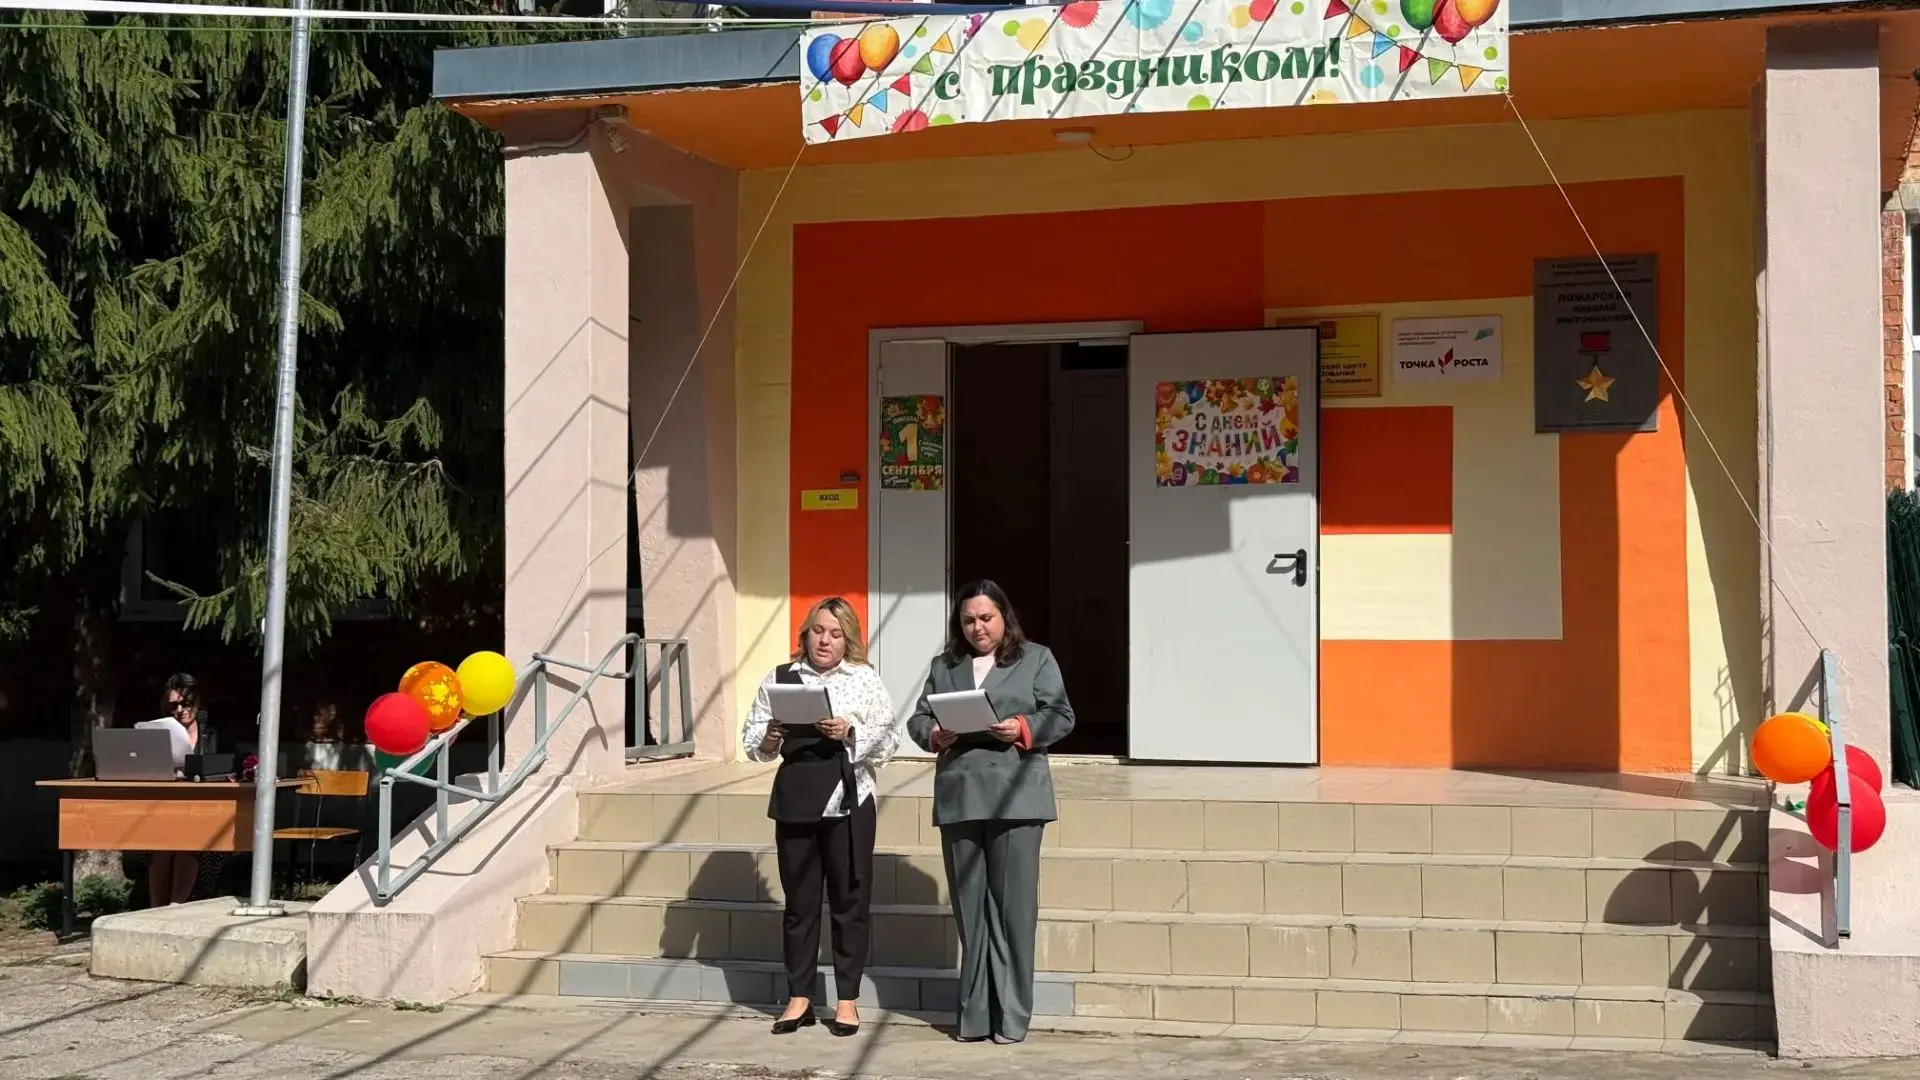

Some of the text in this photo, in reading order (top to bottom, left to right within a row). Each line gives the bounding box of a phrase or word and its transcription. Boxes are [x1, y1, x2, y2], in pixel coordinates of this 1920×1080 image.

[988, 38, 1342, 105] праздником!
[1399, 358, 1489, 369] ТОЧКА РОСТА
[1195, 412, 1207, 431] С
[898, 423, 919, 461] 1
[1172, 420, 1283, 457] ЗНАНИЙ
[882, 465, 943, 475] СЕНТЯБРЯ
